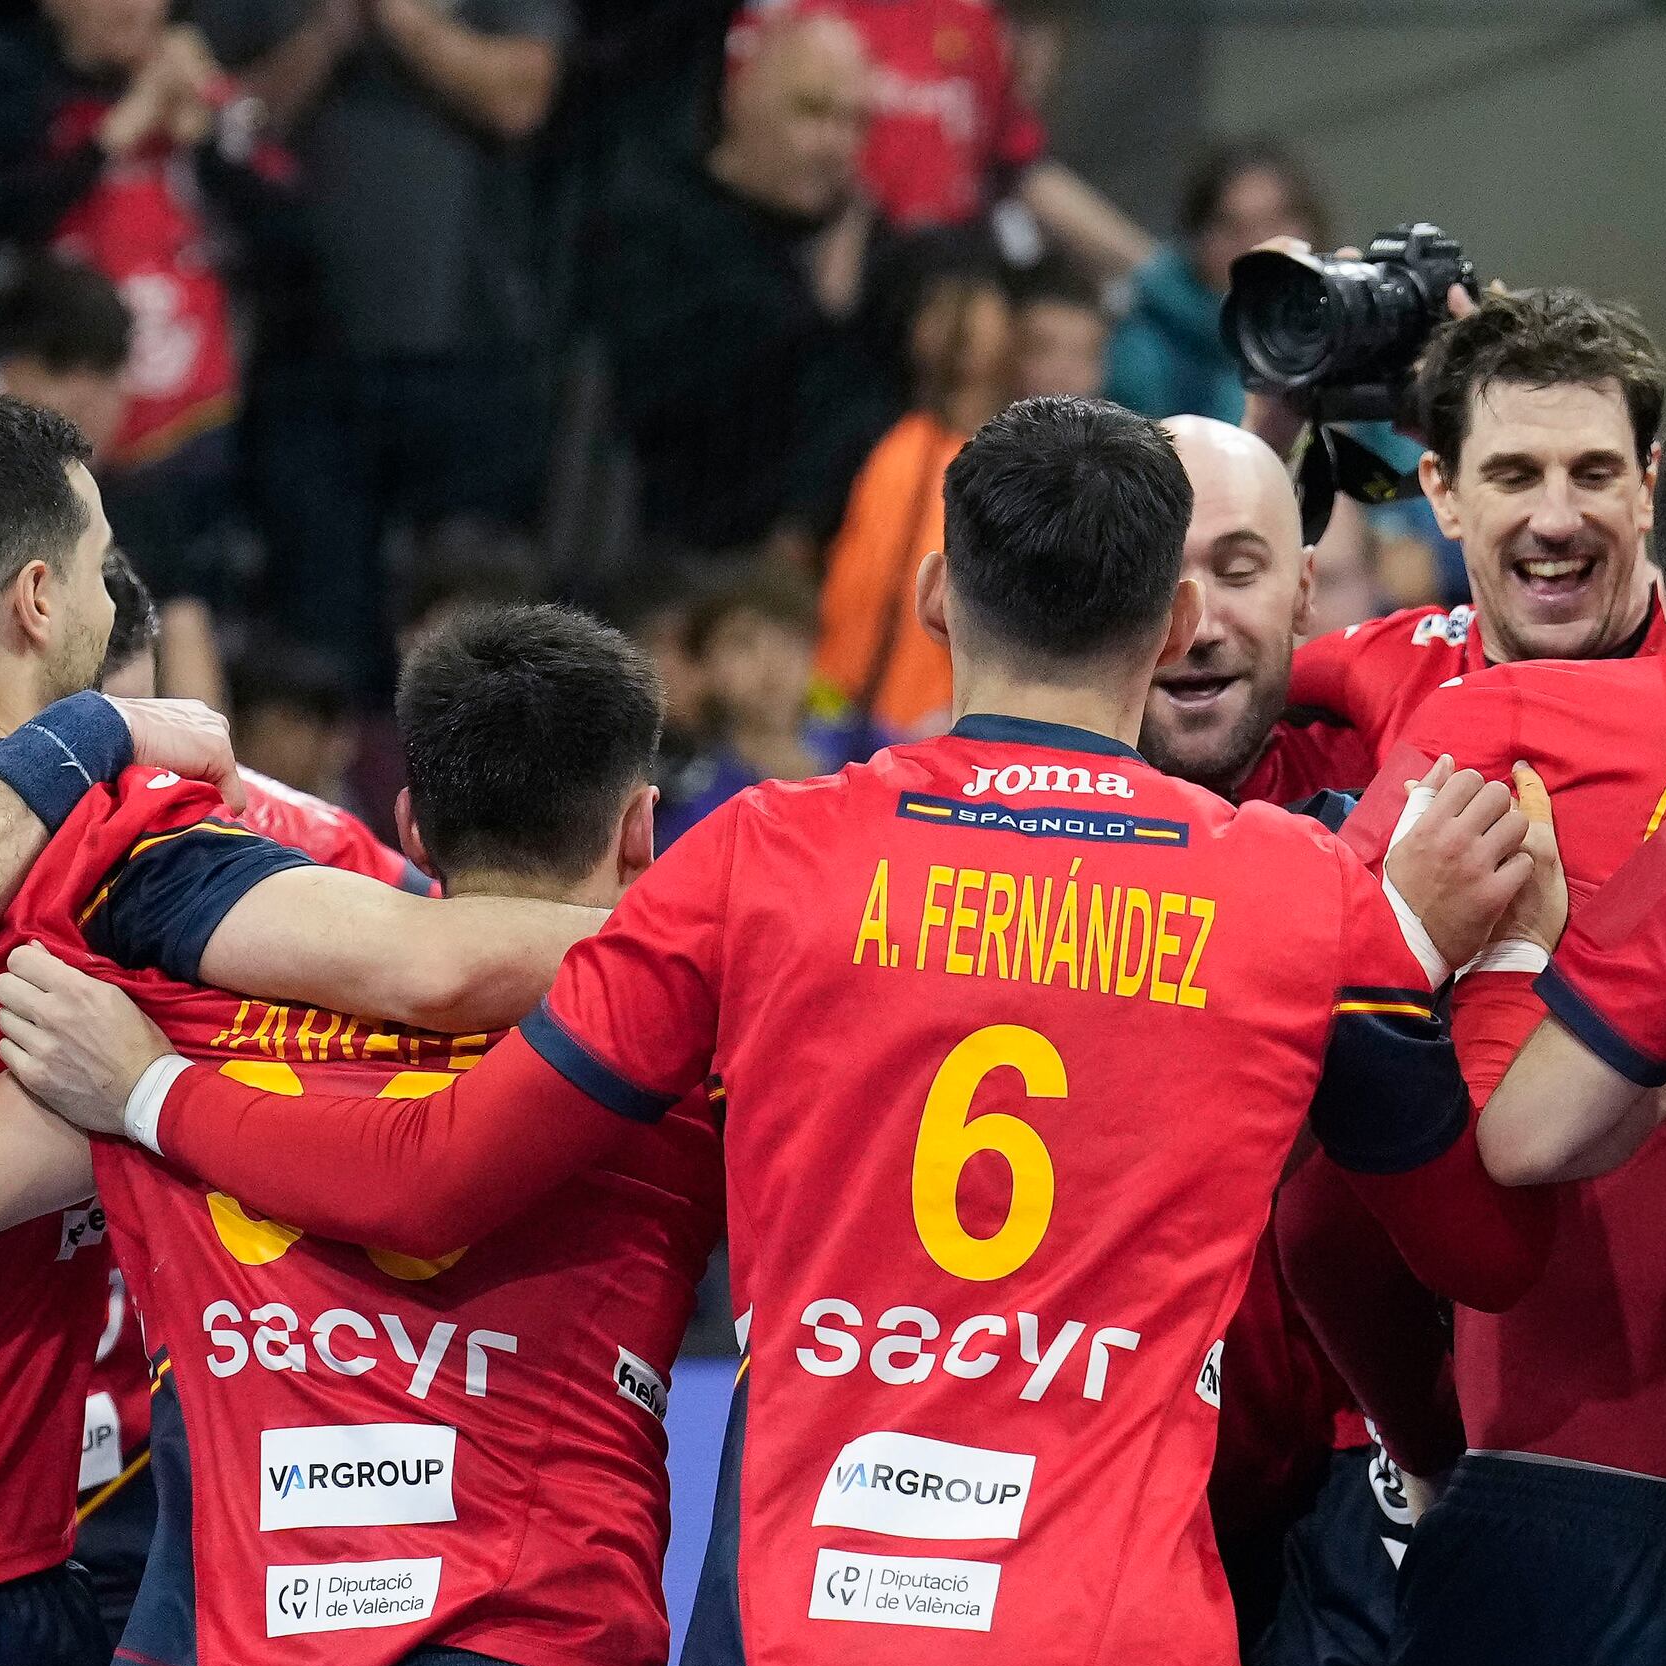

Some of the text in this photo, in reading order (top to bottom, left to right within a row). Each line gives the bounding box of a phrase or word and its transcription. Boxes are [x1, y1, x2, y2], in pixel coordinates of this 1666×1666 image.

[962, 763, 1135, 799] Joma
[853, 856, 1217, 1010] A. FERNÁNDEZ
[911, 1023, 1069, 1282] 6
[201, 1299, 518, 1399] sacyr
[795, 1298, 1140, 1402] sacyr
[269, 1458, 445, 1498] VARGROUP
[836, 1463, 1022, 1506] VARGROUP
[328, 1572, 413, 1596] Diputació
[879, 1569, 970, 1594] Diputació
[326, 1595, 424, 1616] de València
[876, 1592, 981, 1617] de València
